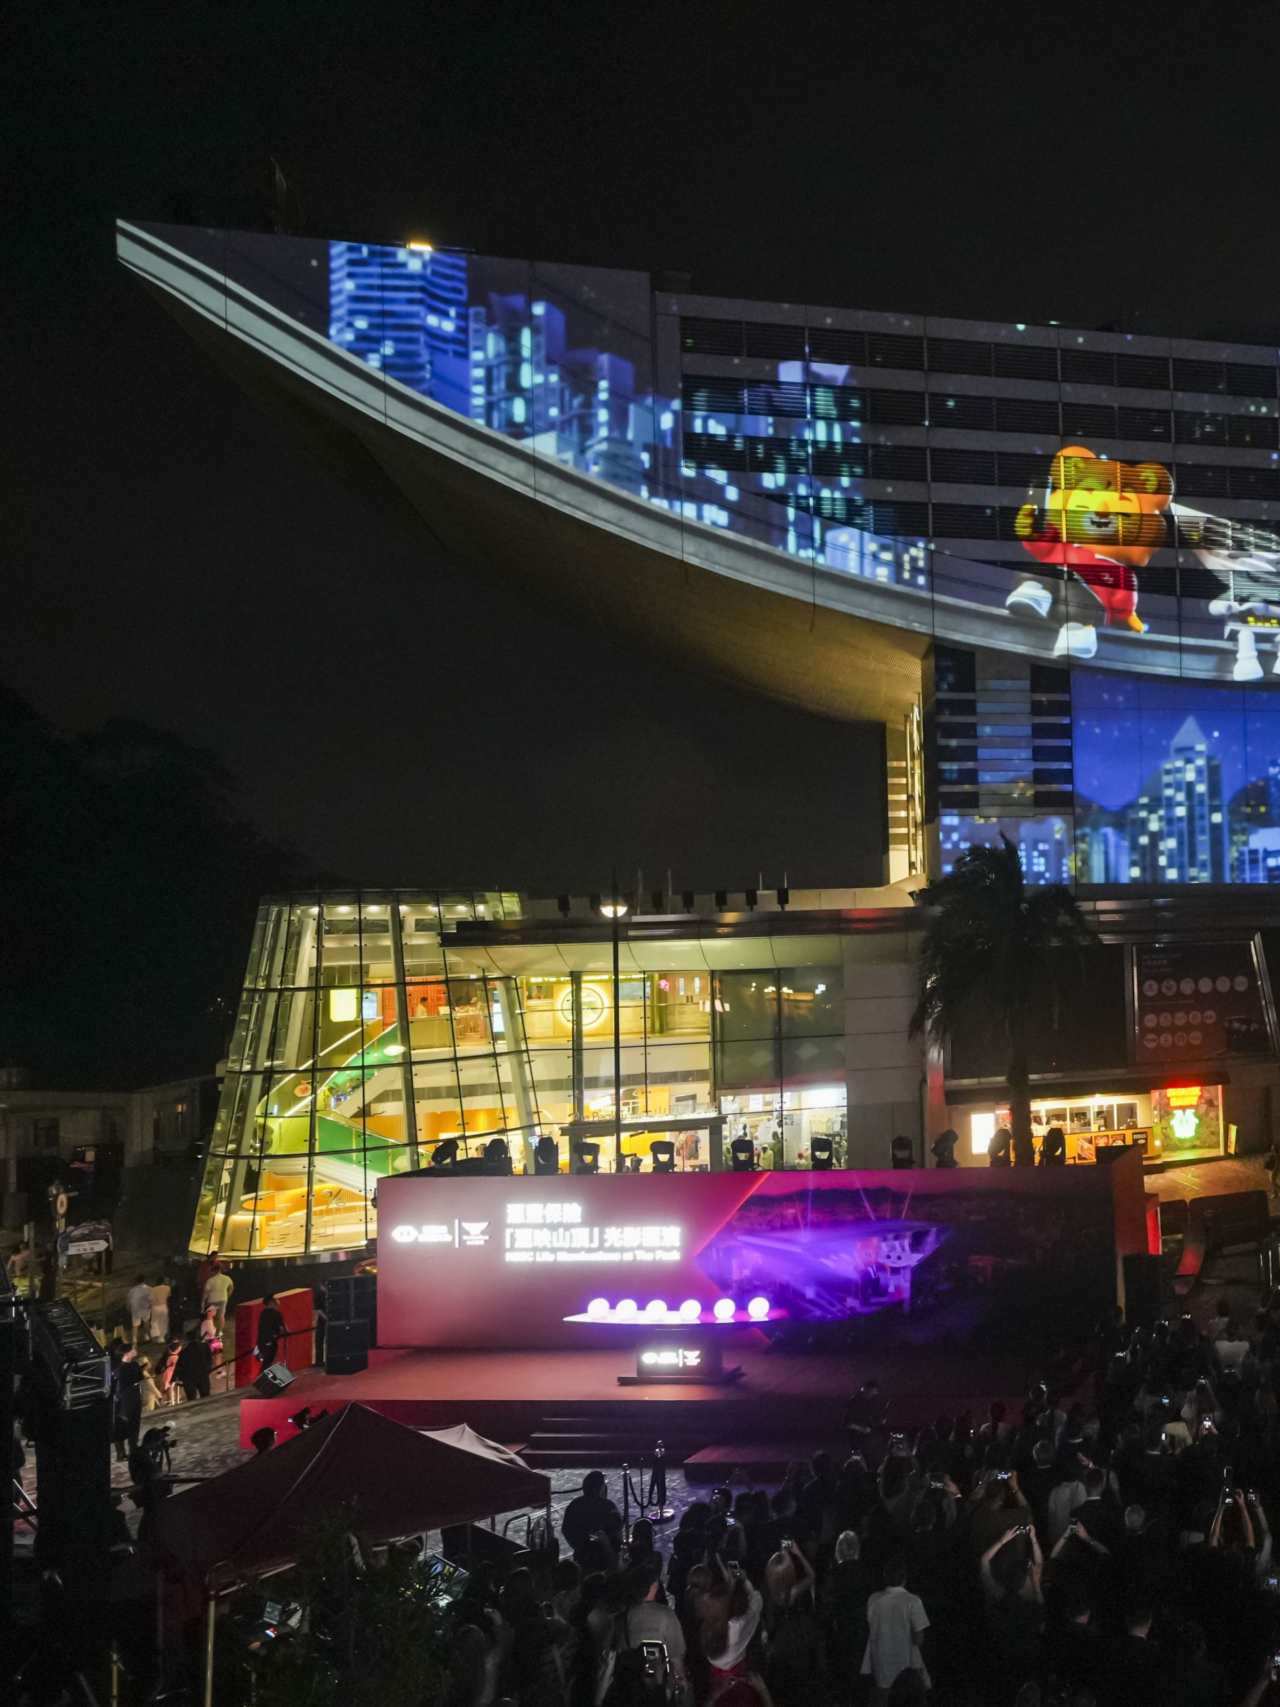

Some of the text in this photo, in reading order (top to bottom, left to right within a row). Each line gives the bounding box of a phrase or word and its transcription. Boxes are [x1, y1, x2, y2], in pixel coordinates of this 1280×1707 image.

[1166, 1086, 1201, 1097] SNACK
[1170, 1096, 1198, 1107] BABY
[634, 1250, 654, 1260] The
[655, 1249, 680, 1260] Peak
